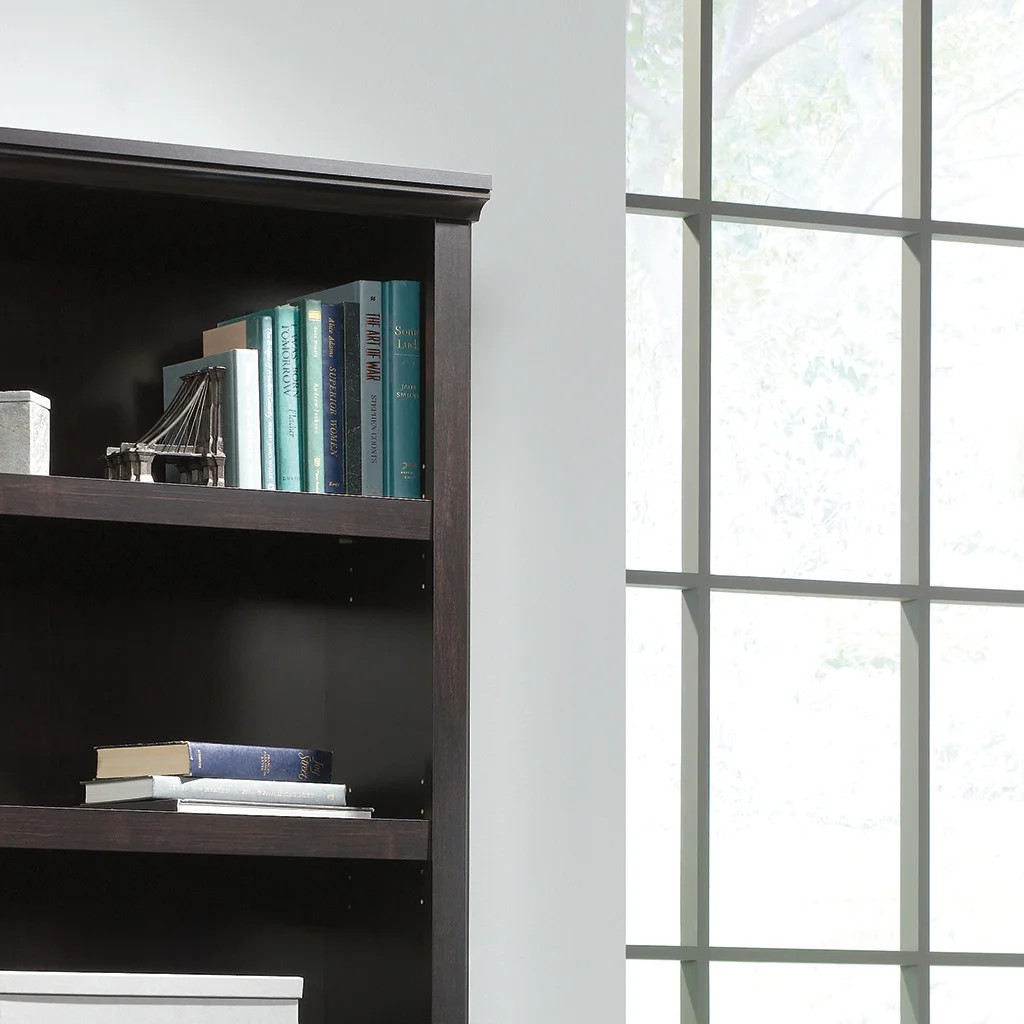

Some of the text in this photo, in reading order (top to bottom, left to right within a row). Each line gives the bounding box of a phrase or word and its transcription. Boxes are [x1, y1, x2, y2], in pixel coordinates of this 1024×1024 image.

[281, 325, 292, 397] TOMORROW
[366, 313, 381, 381] THE ART OF WAR
[292, 367, 300, 398] BORN
[329, 366, 338, 457] SUPERIOR WOMEN
[370, 394, 378, 430] STEPHEN
